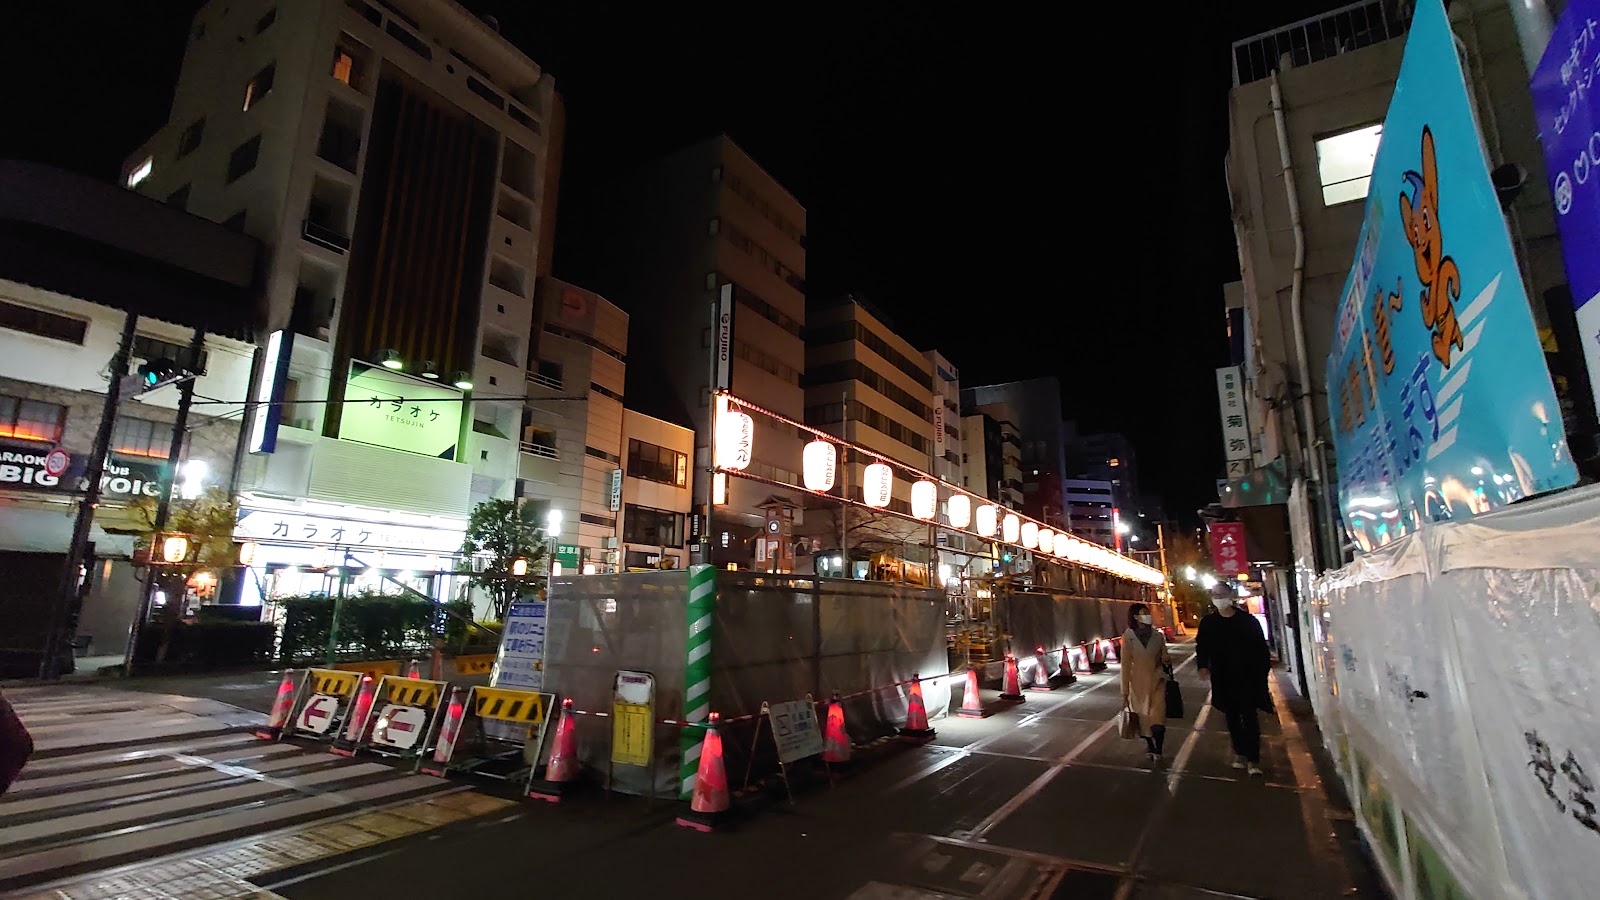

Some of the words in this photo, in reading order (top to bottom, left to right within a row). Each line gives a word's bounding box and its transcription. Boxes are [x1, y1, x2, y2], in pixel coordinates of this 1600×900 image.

[720, 325, 728, 361] FUJIBO
[370, 395, 440, 422] カラオケ
[385, 414, 425, 429] TETSUJIN
[935, 415, 943, 443] FUJIBO
[0, 464, 60, 486] BIG
[272, 520, 373, 544] カラオケ
